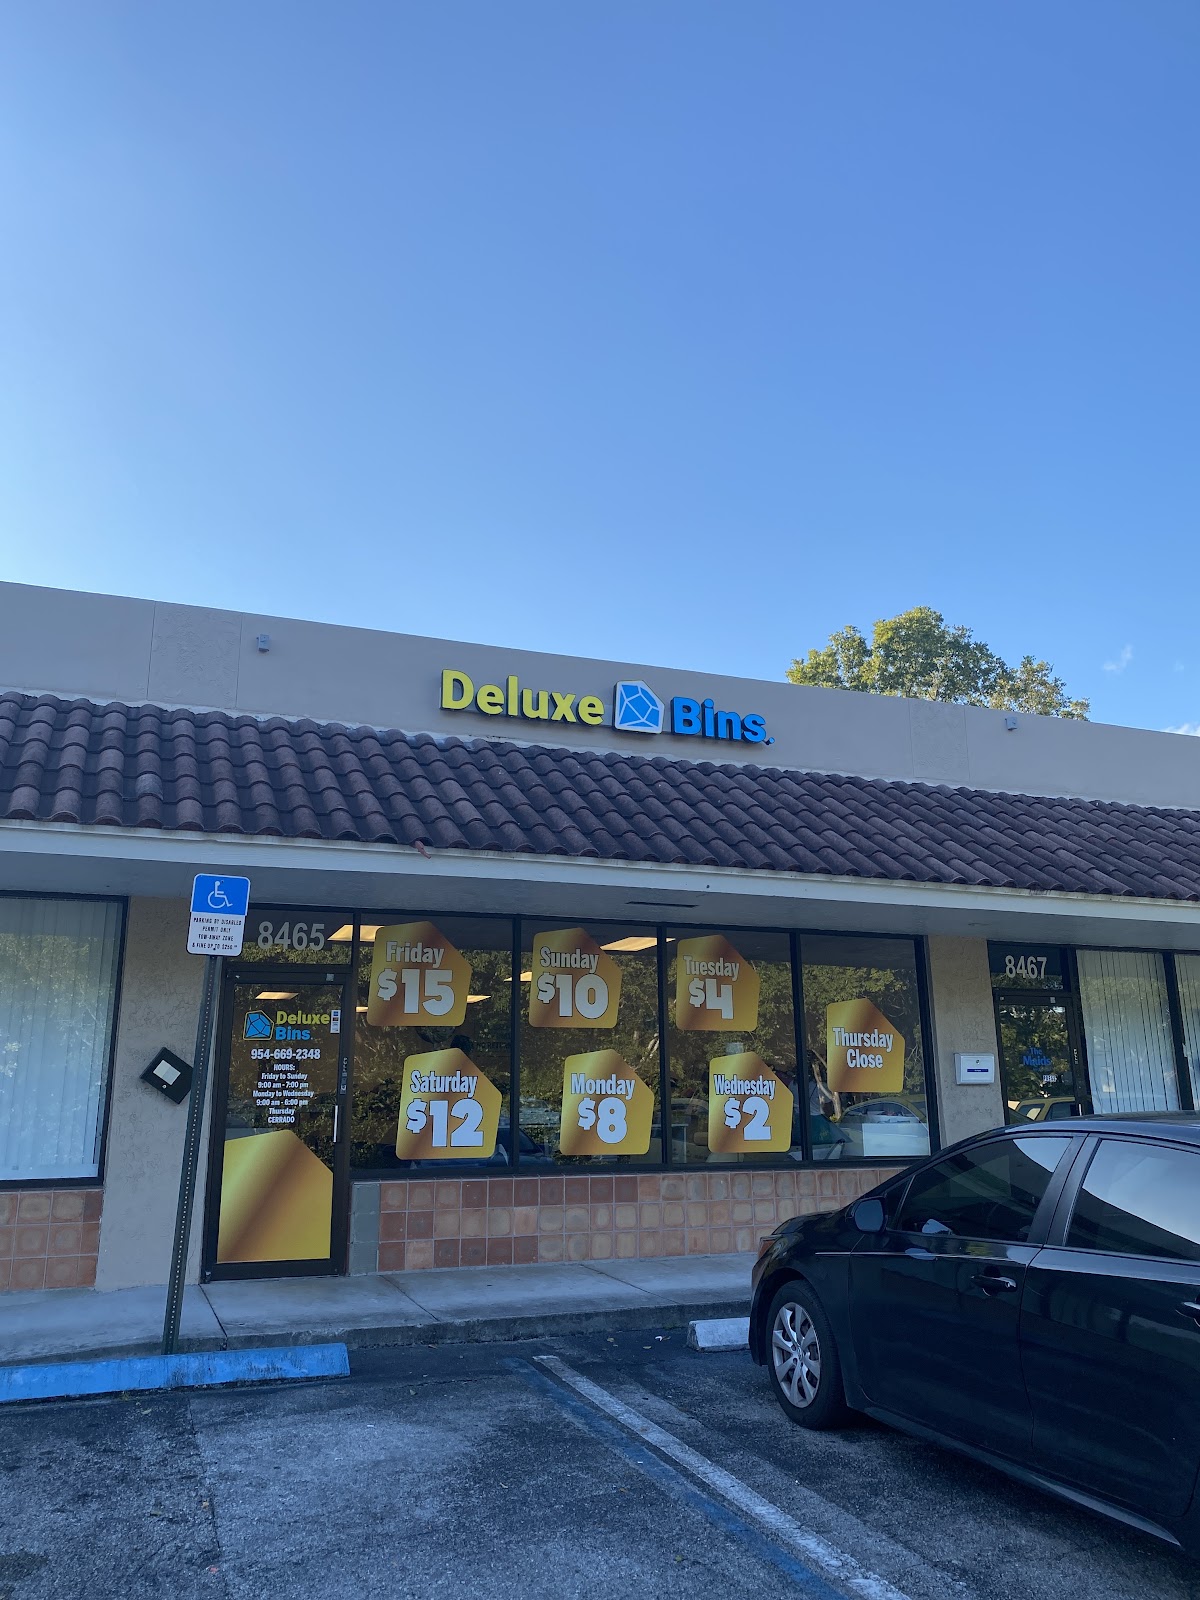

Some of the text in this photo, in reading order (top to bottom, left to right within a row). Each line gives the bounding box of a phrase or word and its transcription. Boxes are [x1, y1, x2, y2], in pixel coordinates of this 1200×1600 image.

[440, 669, 605, 725] Deluxe
[257, 920, 325, 951] 8465
[385, 941, 444, 968] Friday
[540, 946, 599, 974] Sunday
[1005, 955, 1047, 979] 8467
[683, 955, 740, 981] Tuesday
[377, 968, 455, 1016] $15
[537, 972, 609, 1020] $10
[688, 978, 734, 1020] $4
[276, 1010, 330, 1025] Deluxe
[832, 1027, 893, 1049] Thursday
[250, 1048, 321, 1060] 954-669-2348
[273, 1063, 296, 1071] HOURS:
[846, 1049, 883, 1068] Close
[261, 1072, 279, 1080] Friday
[287, 1072, 308, 1080] Sunday
[299, 1082, 309, 1090] pm
[410, 1070, 478, 1097] Saturday
[570, 1073, 635, 1100] Monday
[713, 1074, 776, 1100] Wednesday
[252, 1090, 276, 1098] Monday
[282, 1090, 315, 1098] Wednesday
[267, 1116, 296, 1124] CERRADO
[269, 1107, 296, 1116] Thursday
[406, 1097, 484, 1147] $12
[577, 1097, 627, 1144] $8
[724, 1096, 772, 1141] $2
